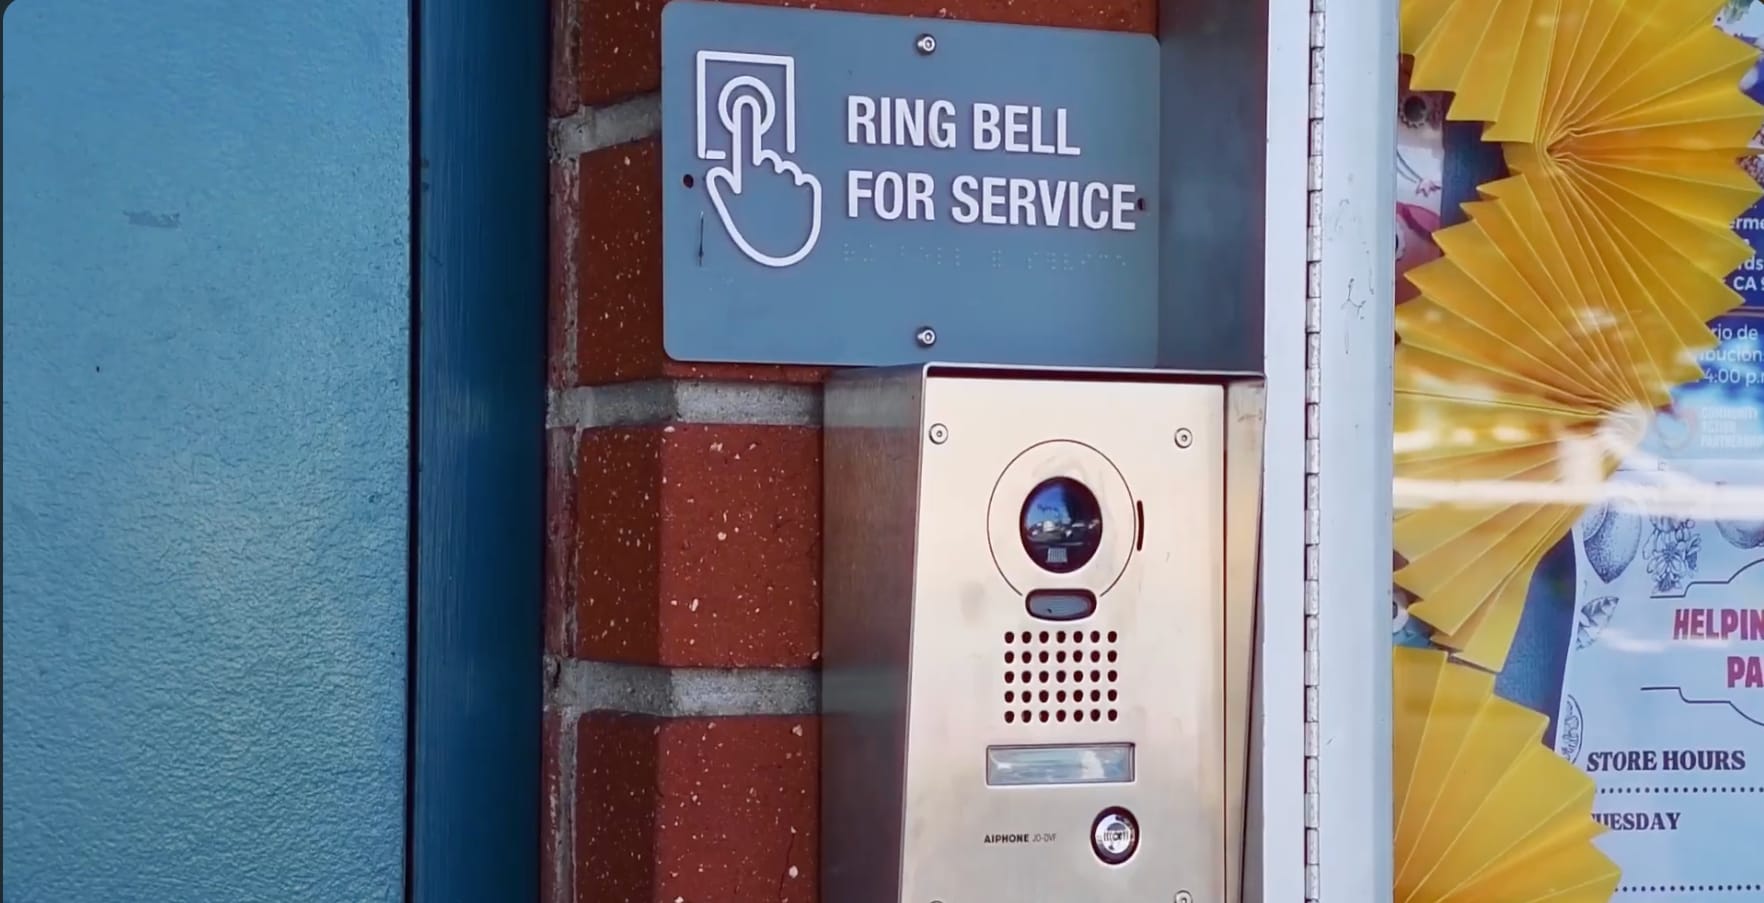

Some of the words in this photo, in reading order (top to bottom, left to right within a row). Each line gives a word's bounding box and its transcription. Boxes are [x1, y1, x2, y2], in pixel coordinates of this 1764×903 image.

[848, 95, 956, 149] RING
[973, 103, 1081, 155] BELL
[848, 170, 935, 220] FOR
[951, 175, 1136, 231] SERVICE
[1733, 276, 1758, 291] CA
[1737, 324, 1759, 340] de
[1704, 367, 1741, 384] 4:00
[1727, 656, 1764, 688] PA
[1586, 751, 1657, 772] STORE
[1662, 750, 1746, 771] HOURS
[984, 834, 1029, 844] AIPHONE
